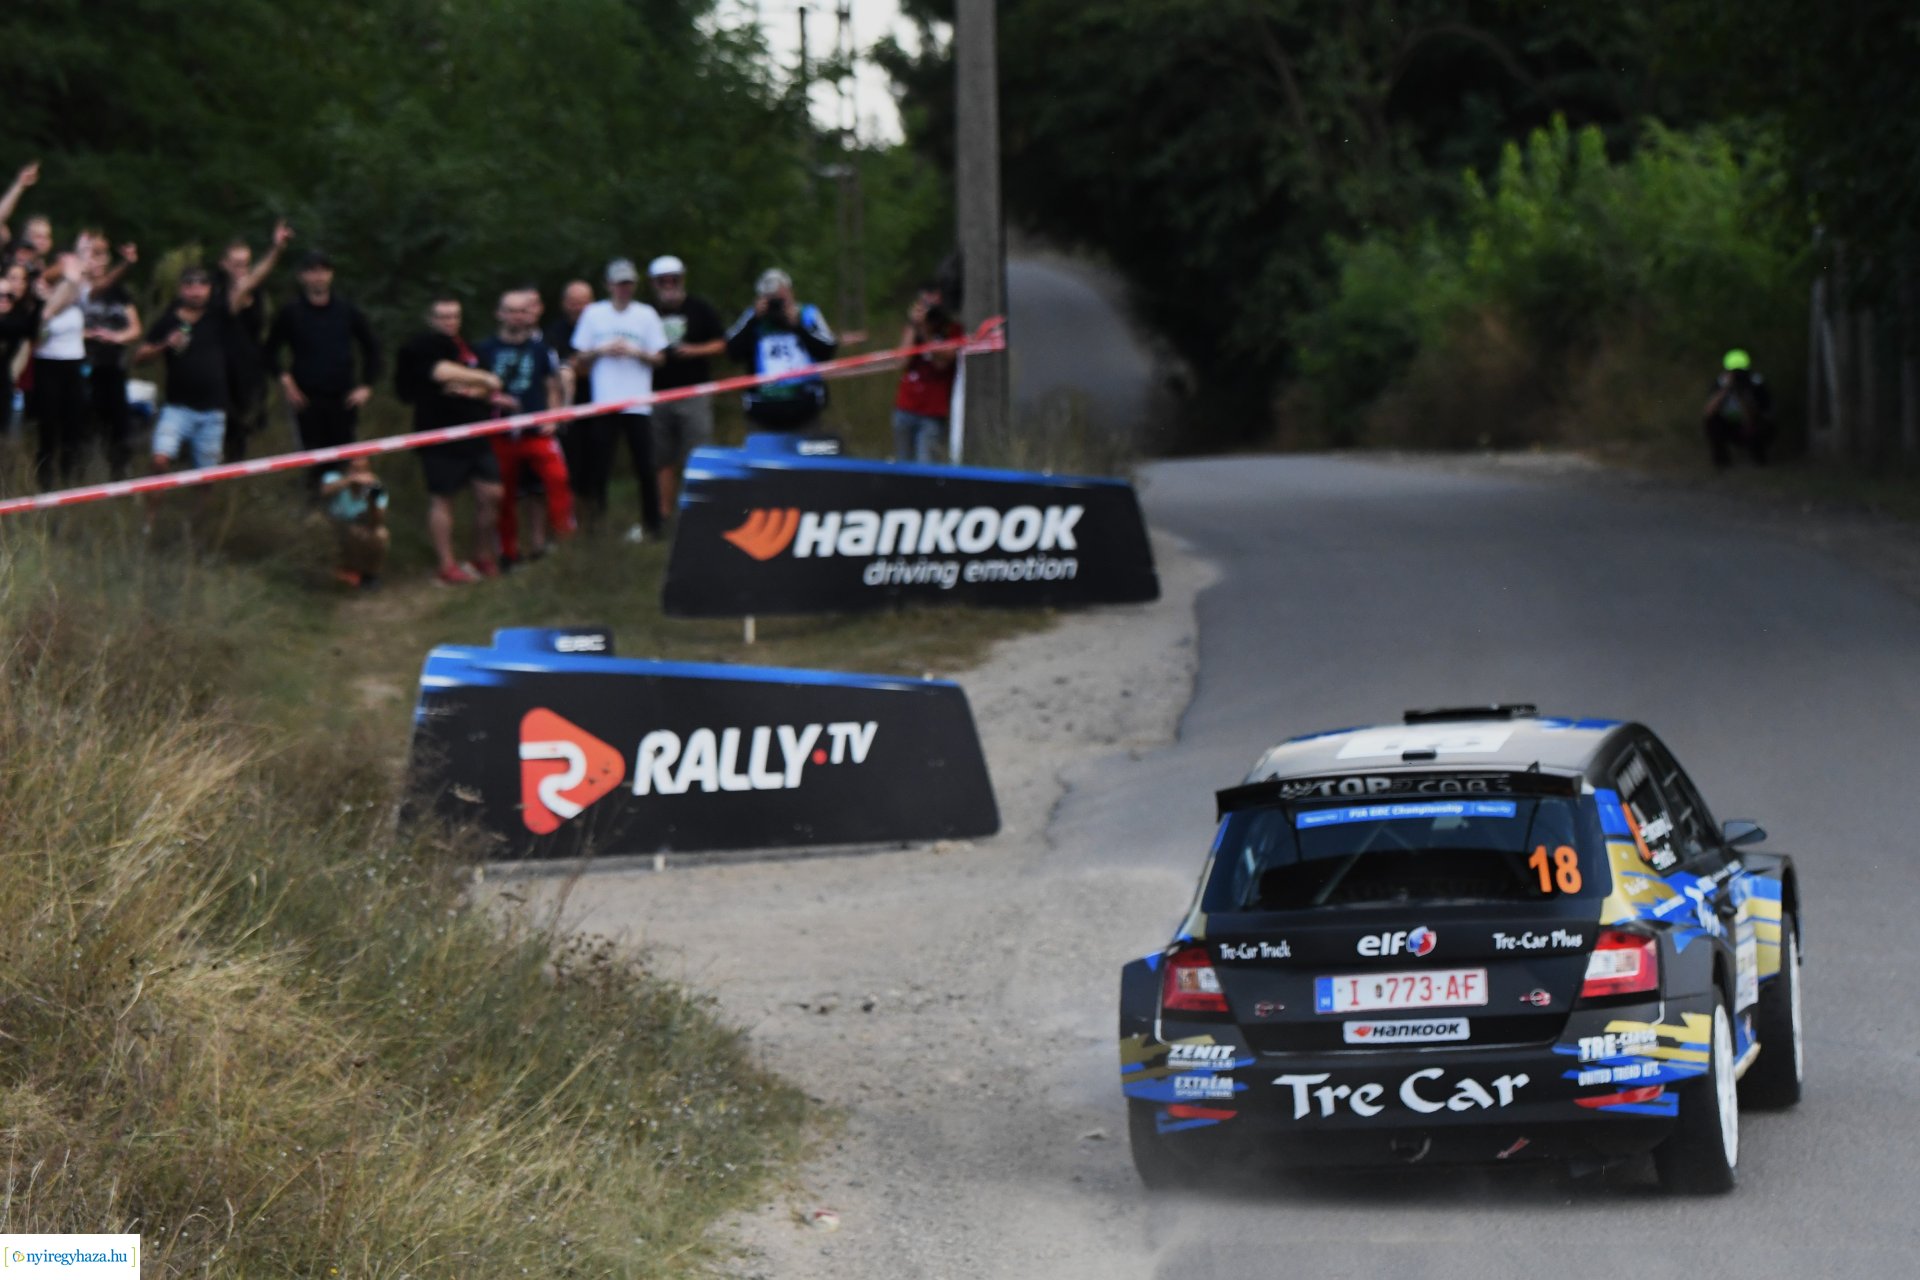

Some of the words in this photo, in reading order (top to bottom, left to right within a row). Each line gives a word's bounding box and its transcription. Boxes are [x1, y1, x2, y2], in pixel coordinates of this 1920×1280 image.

[863, 558, 960, 590] driving
[963, 556, 1078, 583] emotion
[1392, 803, 1464, 815] Championship
[1528, 844, 1582, 894] 18
[1259, 939, 1291, 958] Truck
[1356, 931, 1408, 957] elf
[1492, 931, 1549, 950] Tre-Car
[1551, 929, 1583, 948] Plus
[1168, 1044, 1236, 1059] ZENIT
[1271, 1072, 1386, 1120] Tre
[1399, 1067, 1531, 1114] Car
